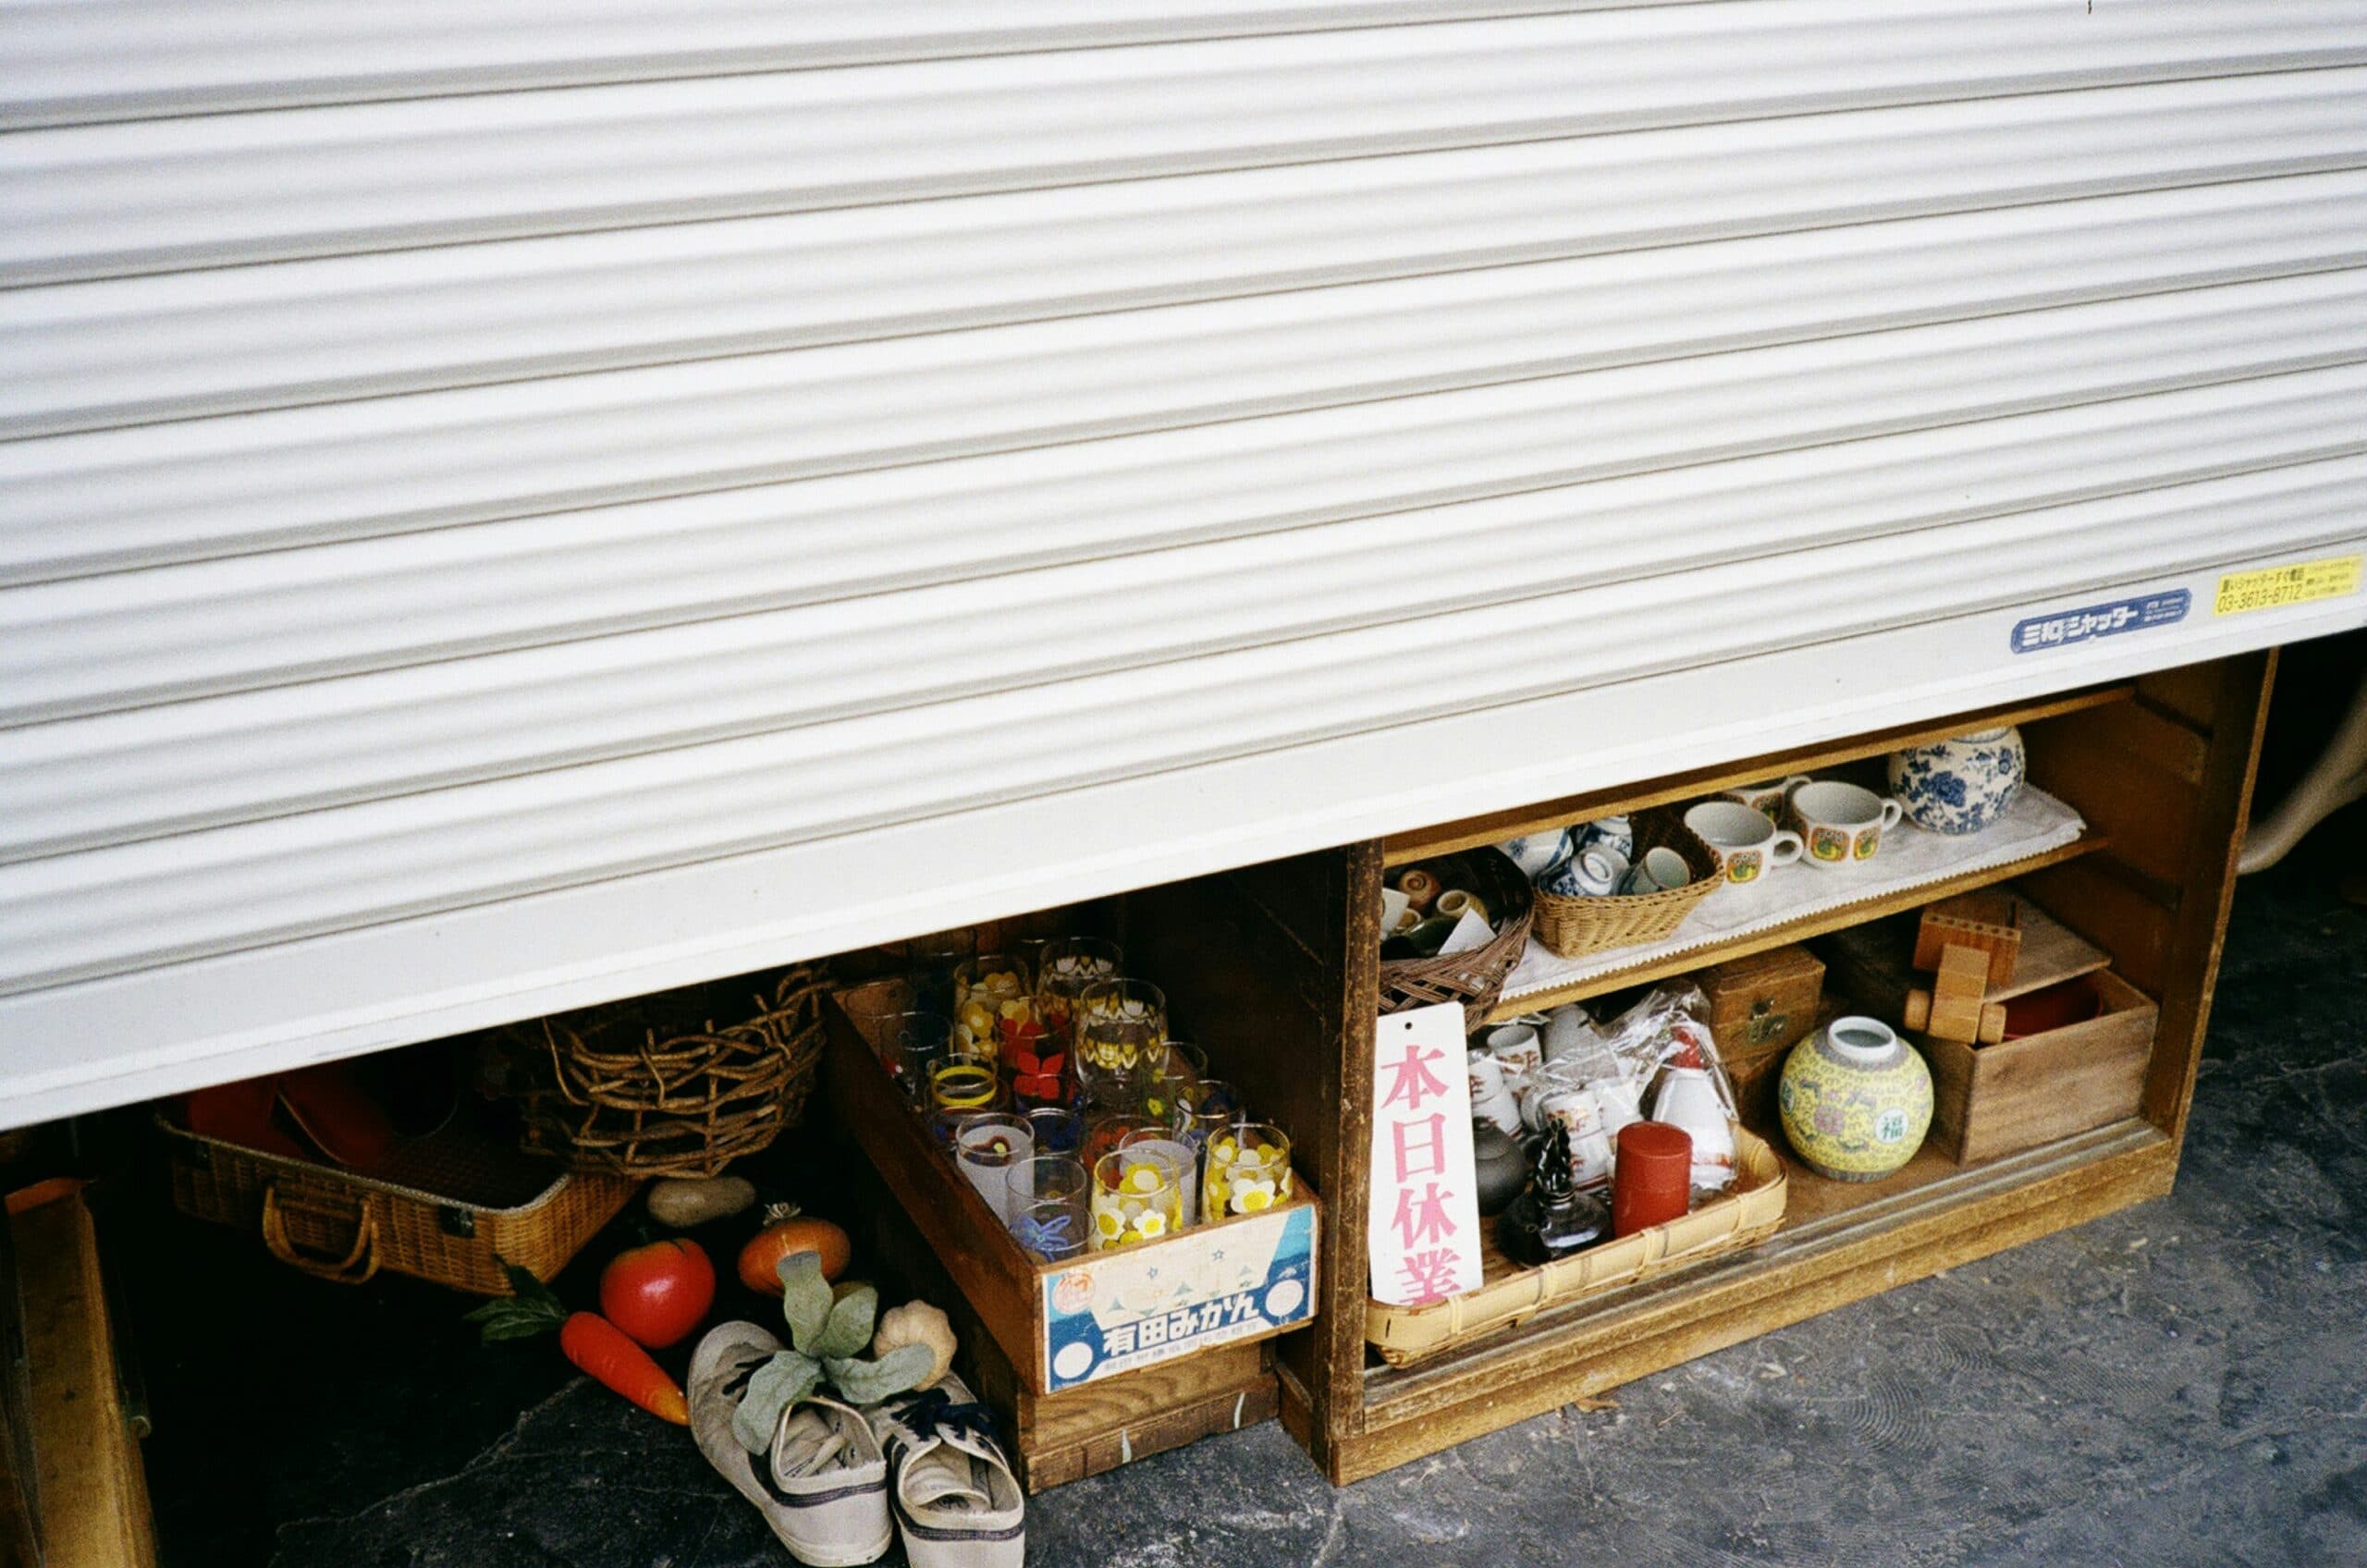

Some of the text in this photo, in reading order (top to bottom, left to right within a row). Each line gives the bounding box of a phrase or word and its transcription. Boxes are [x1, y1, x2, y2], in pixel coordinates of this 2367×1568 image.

[2022, 606, 2139, 646] 三和シャッター
[1380, 1045, 1462, 1305] 本日休業
[1103, 1292, 1260, 1356] 有田みかん
